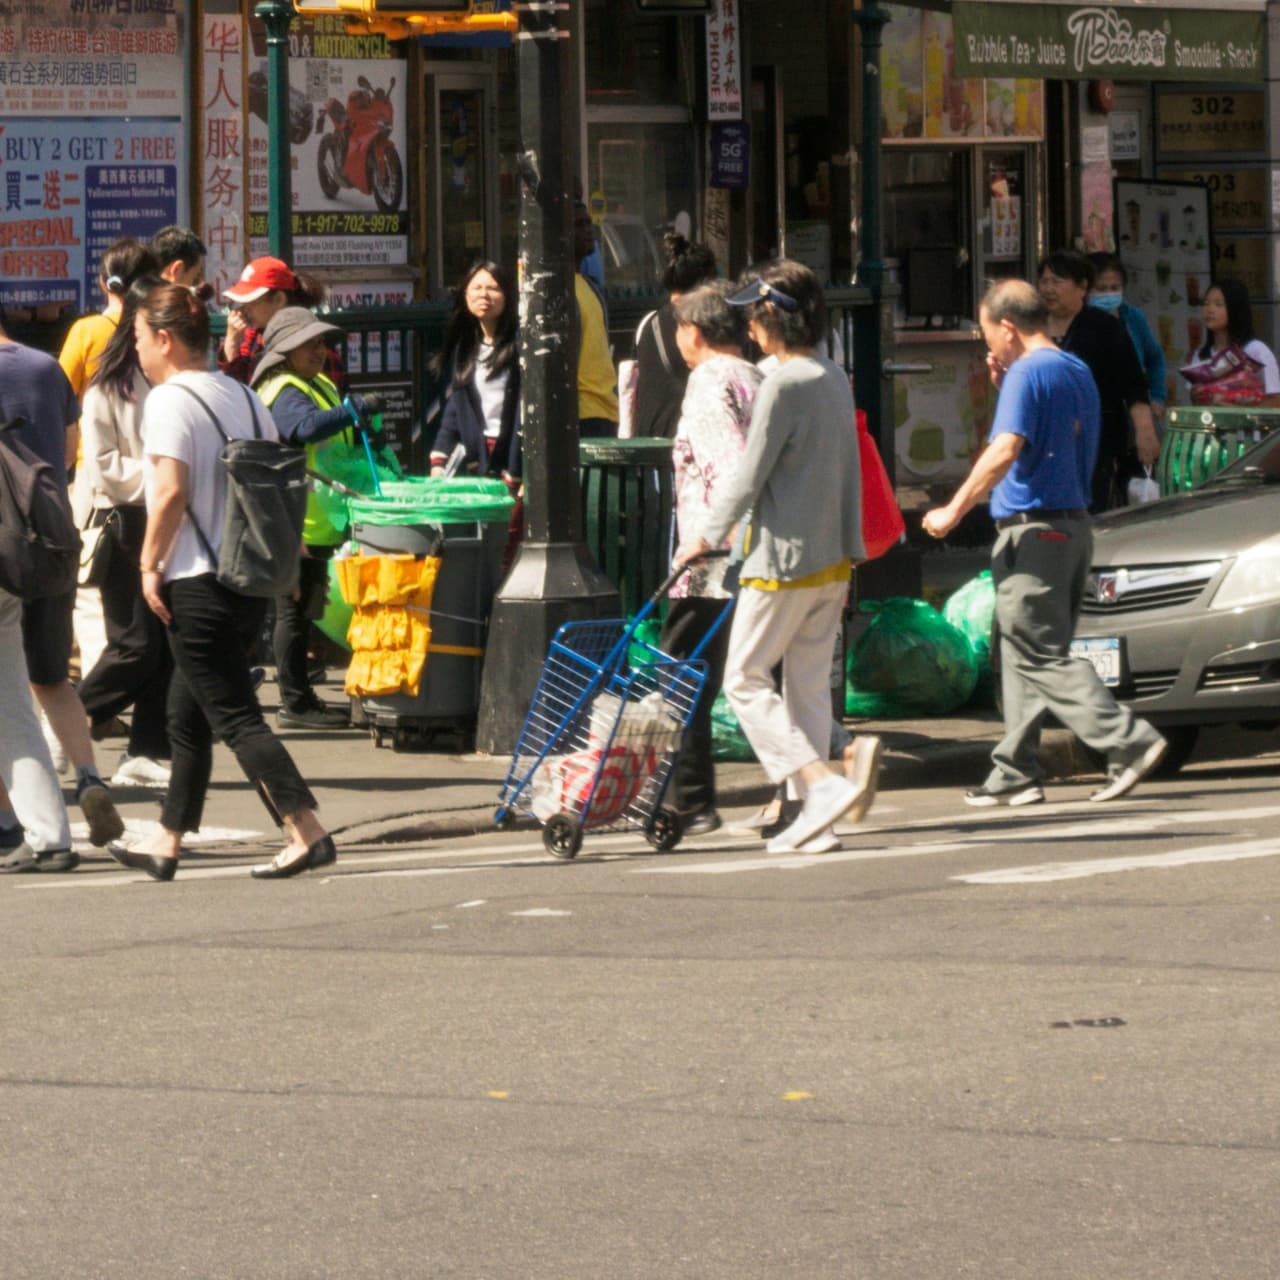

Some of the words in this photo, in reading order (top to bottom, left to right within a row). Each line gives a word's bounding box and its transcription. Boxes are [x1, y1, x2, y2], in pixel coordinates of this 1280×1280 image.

[302, 35, 311, 58] &
[313, 34, 391, 59] MOTORCYCLE
[967, 34, 1007, 64] Bubble
[1038, 39, 1066, 65] Juice
[1174, 39, 1221, 70] Smoothie
[1227, 40, 1259, 70] Snack
[709, 31, 721, 97] PHONE
[1191, 96, 1235, 116] 302
[5, 136, 44, 161] BUY
[51, 136, 61, 161] 2
[68, 137, 107, 161] GET
[114, 137, 124, 161] 2
[130, 137, 176, 161] FREE
[720, 143, 742, 158] 5G
[718, 161, 743, 173] FREE
[348, 240, 373, 253] Flushing
[0, 250, 69, 278] OFFER
